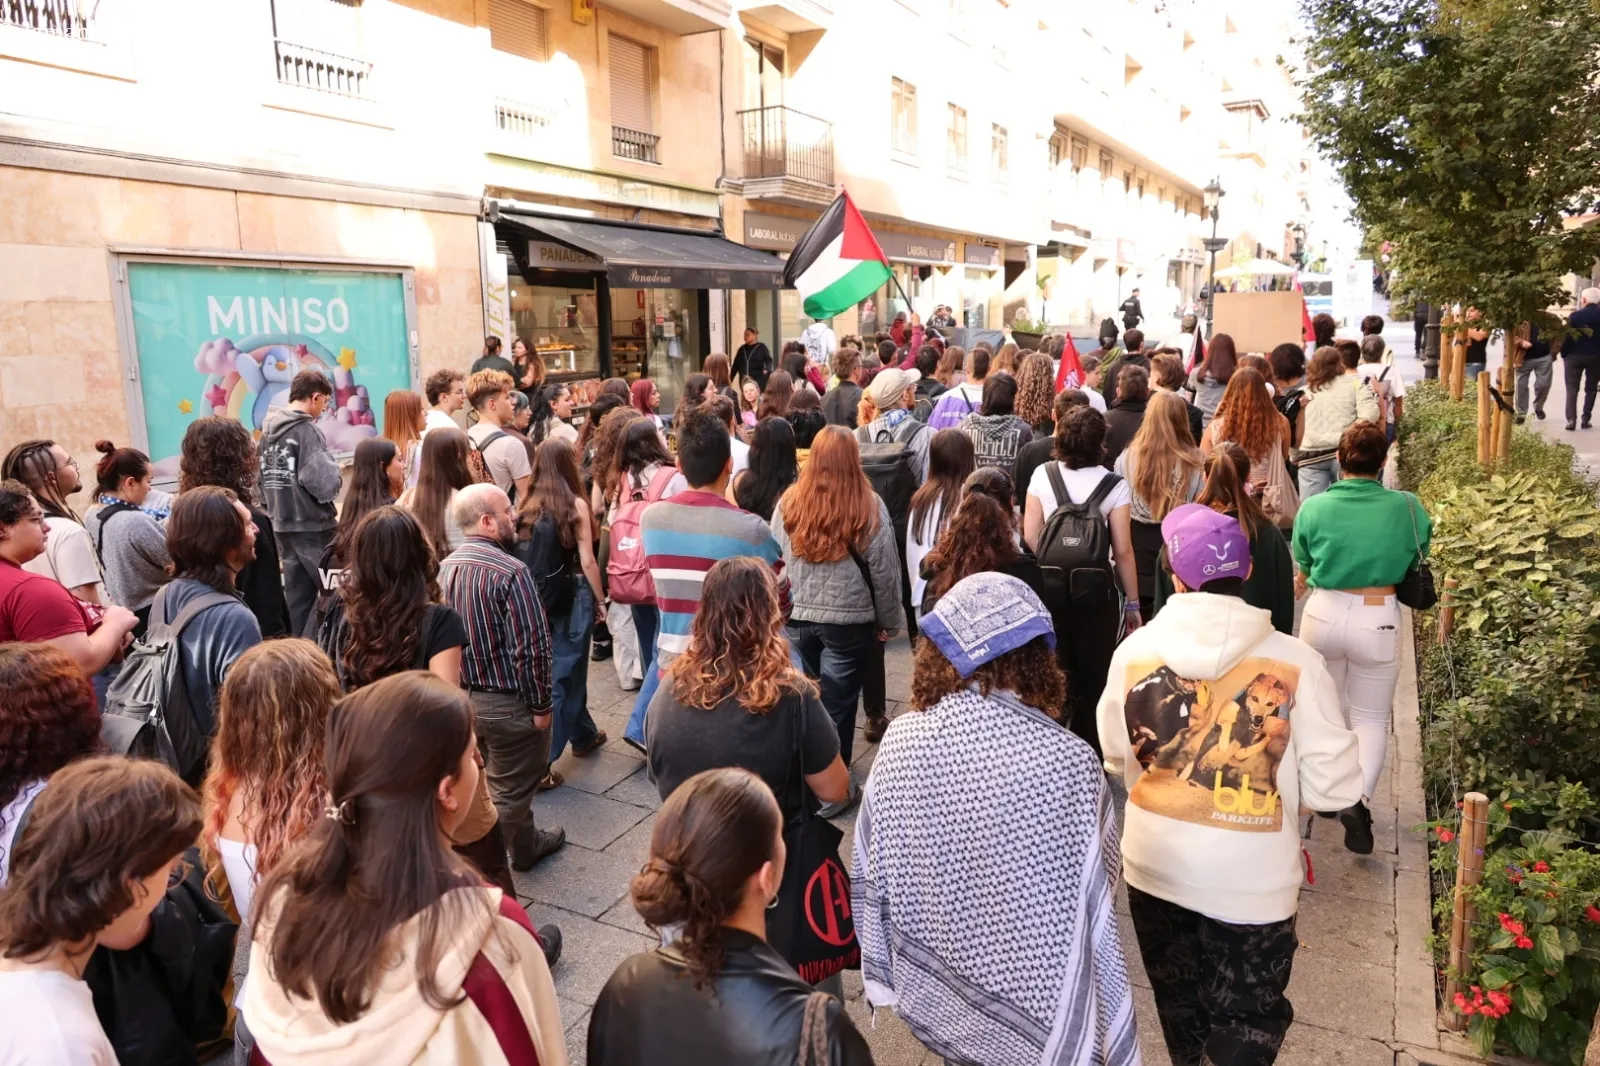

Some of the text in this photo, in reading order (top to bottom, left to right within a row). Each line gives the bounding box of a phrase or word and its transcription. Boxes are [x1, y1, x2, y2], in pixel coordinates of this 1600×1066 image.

[749, 227, 779, 241] LABORAL
[907, 244, 929, 257] LABORAL
[206, 295, 351, 335] MINISO
[1213, 771, 1280, 816] blur
[1210, 811, 1273, 826] PARKLIFE
